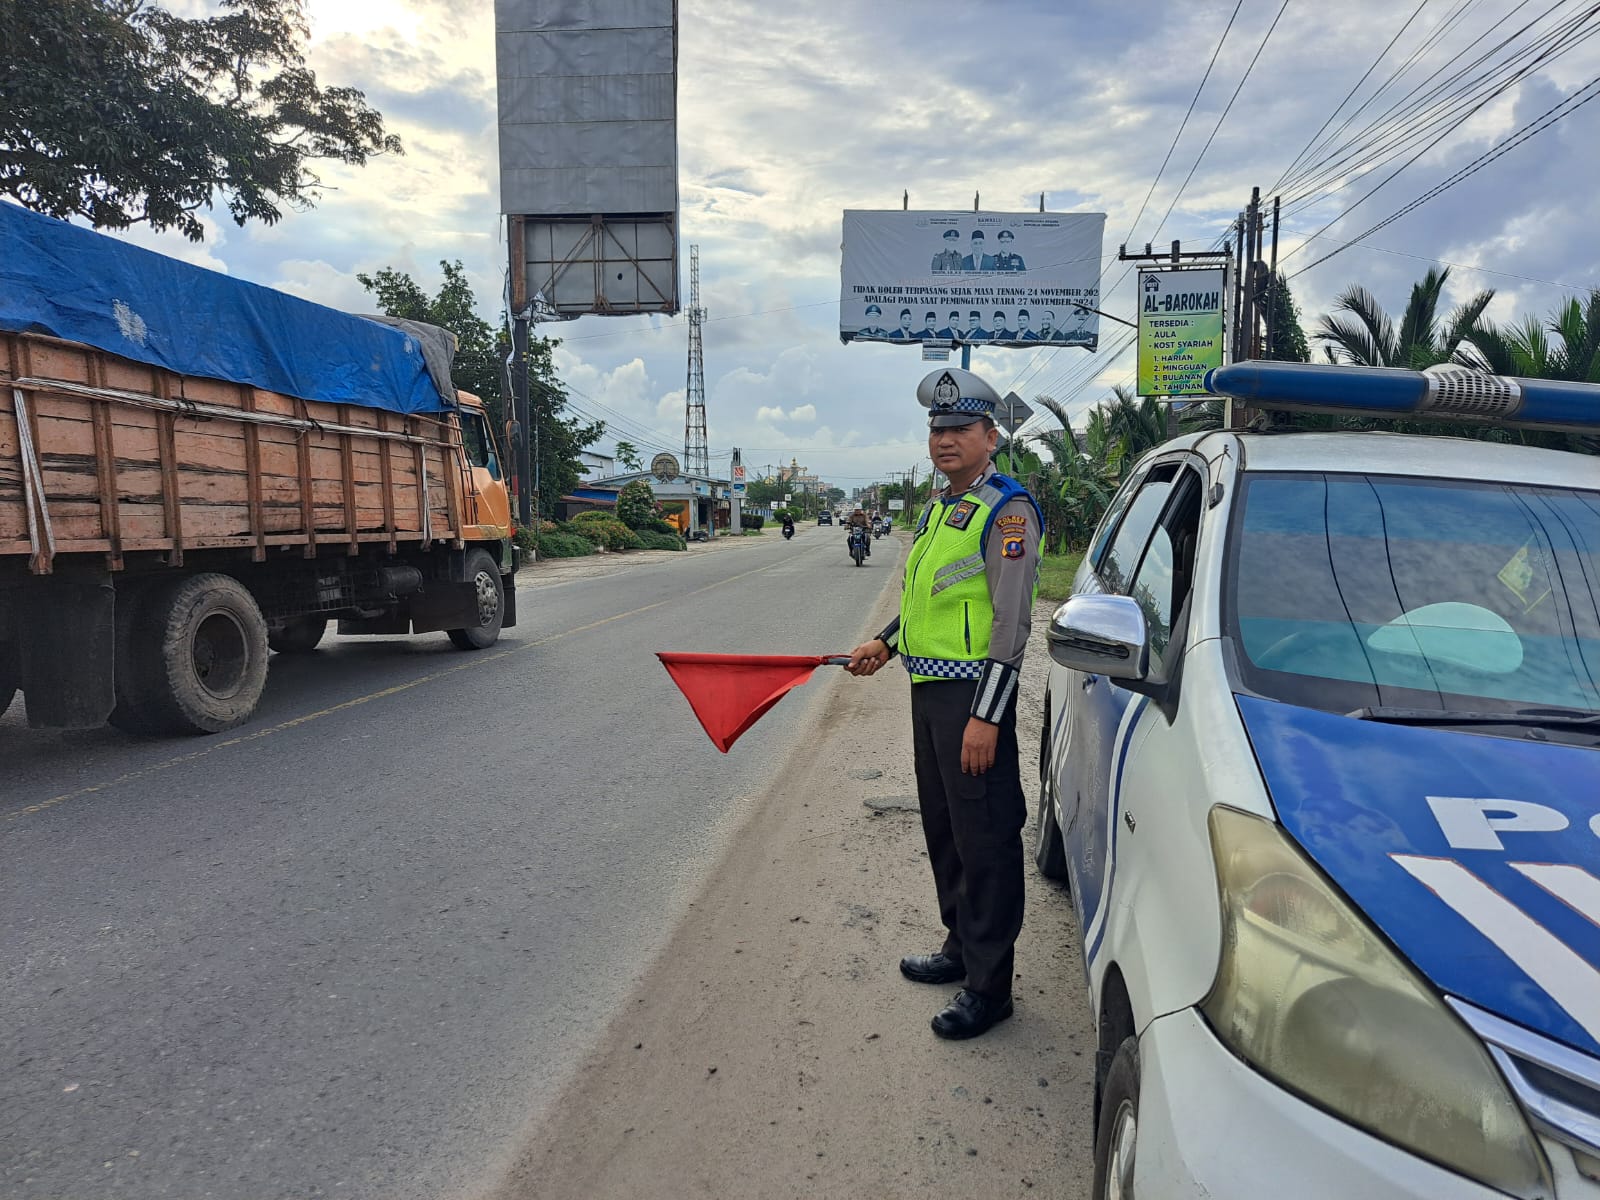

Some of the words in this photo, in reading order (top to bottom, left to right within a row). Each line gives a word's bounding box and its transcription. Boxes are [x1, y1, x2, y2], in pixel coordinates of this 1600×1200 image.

[853, 285, 875, 294] TIDAK
[878, 286, 903, 295] BOLEH
[905, 286, 948, 296] TERPASANG
[950, 287, 972, 296] SEJAK
[974, 287, 994, 296] MASA
[996, 287, 1025, 296] TENANG
[1027, 288, 1038, 296] 24
[1040, 288, 1081, 297] NOVEMBER
[864, 295, 896, 304] APALAGI
[898, 296, 918, 305] PADA
[920, 296, 938, 305] SAAT
[940, 297, 989, 306] PEMUNGUTAN
[991, 297, 1015, 306] SUARA
[1017, 298, 1028, 306] 27
[1030, 298, 1071, 306] NOVEMBER
[1144, 292, 1219, 312] AL-BAROKAH
[1149, 319, 1189, 328] TERSEDIA
[1154, 331, 1176, 339] AULA
[1153, 341, 1175, 349] KOST
[1177, 340, 1213, 349] SYARIAH
[1162, 363, 1207, 371] MINGGUAN
[1162, 373, 1203, 381] BULANAN
[1163, 383, 1203, 391] TAHUNAN
[1425, 796, 1600, 851] P
